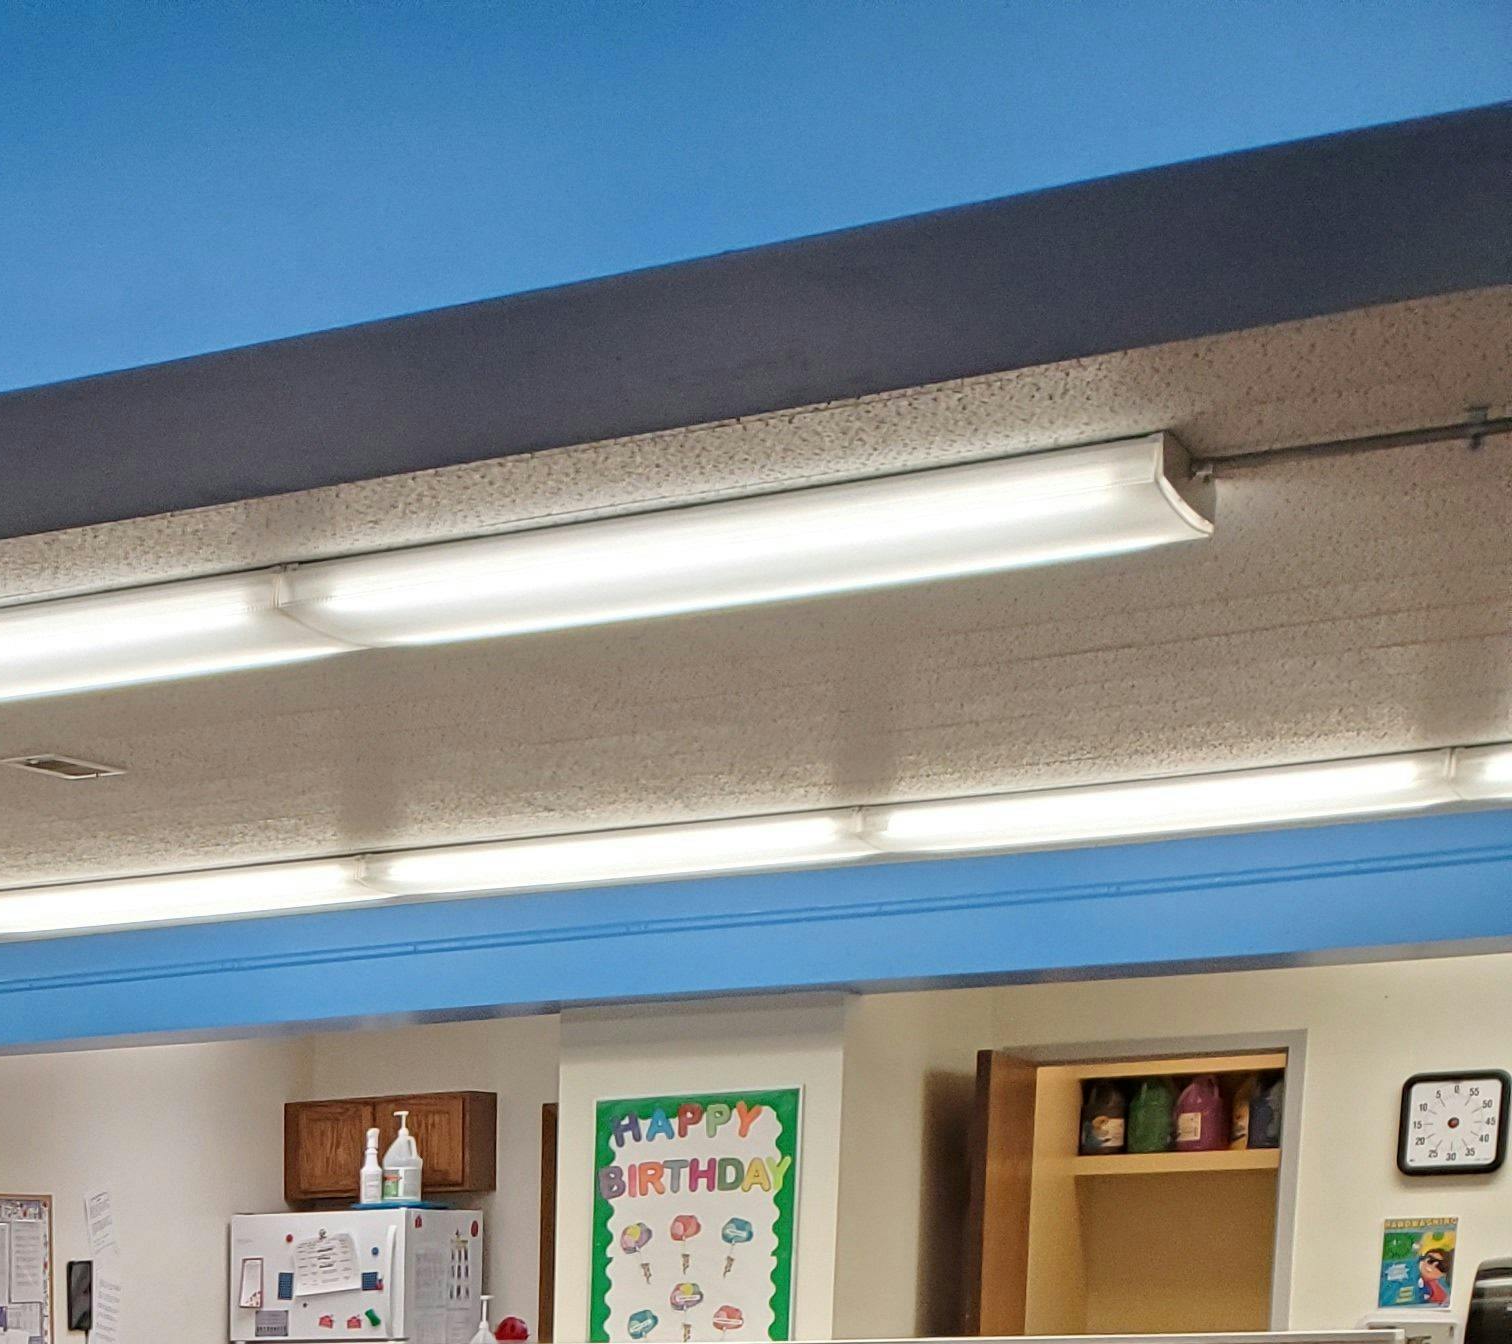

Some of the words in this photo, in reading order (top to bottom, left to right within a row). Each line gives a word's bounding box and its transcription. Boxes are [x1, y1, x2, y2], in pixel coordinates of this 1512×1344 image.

[1469, 1087, 1480, 1097] 55
[1419, 1103, 1428, 1112] 10
[1482, 1099, 1493, 1109] 50
[612, 1100, 764, 1148] HAPPY
[1413, 1120, 1422, 1129] 15
[1485, 1117, 1496, 1126] 45
[1415, 1136, 1426, 1146] 20
[1479, 1133, 1490, 1143] 40
[1428, 1149, 1439, 1159] 25
[1445, 1152, 1457, 1161] 30
[1465, 1147, 1476, 1157] 35
[598, 1155, 792, 1200] BIRTHDAY
[1385, 1217, 1457, 1229] HANDWASHING
